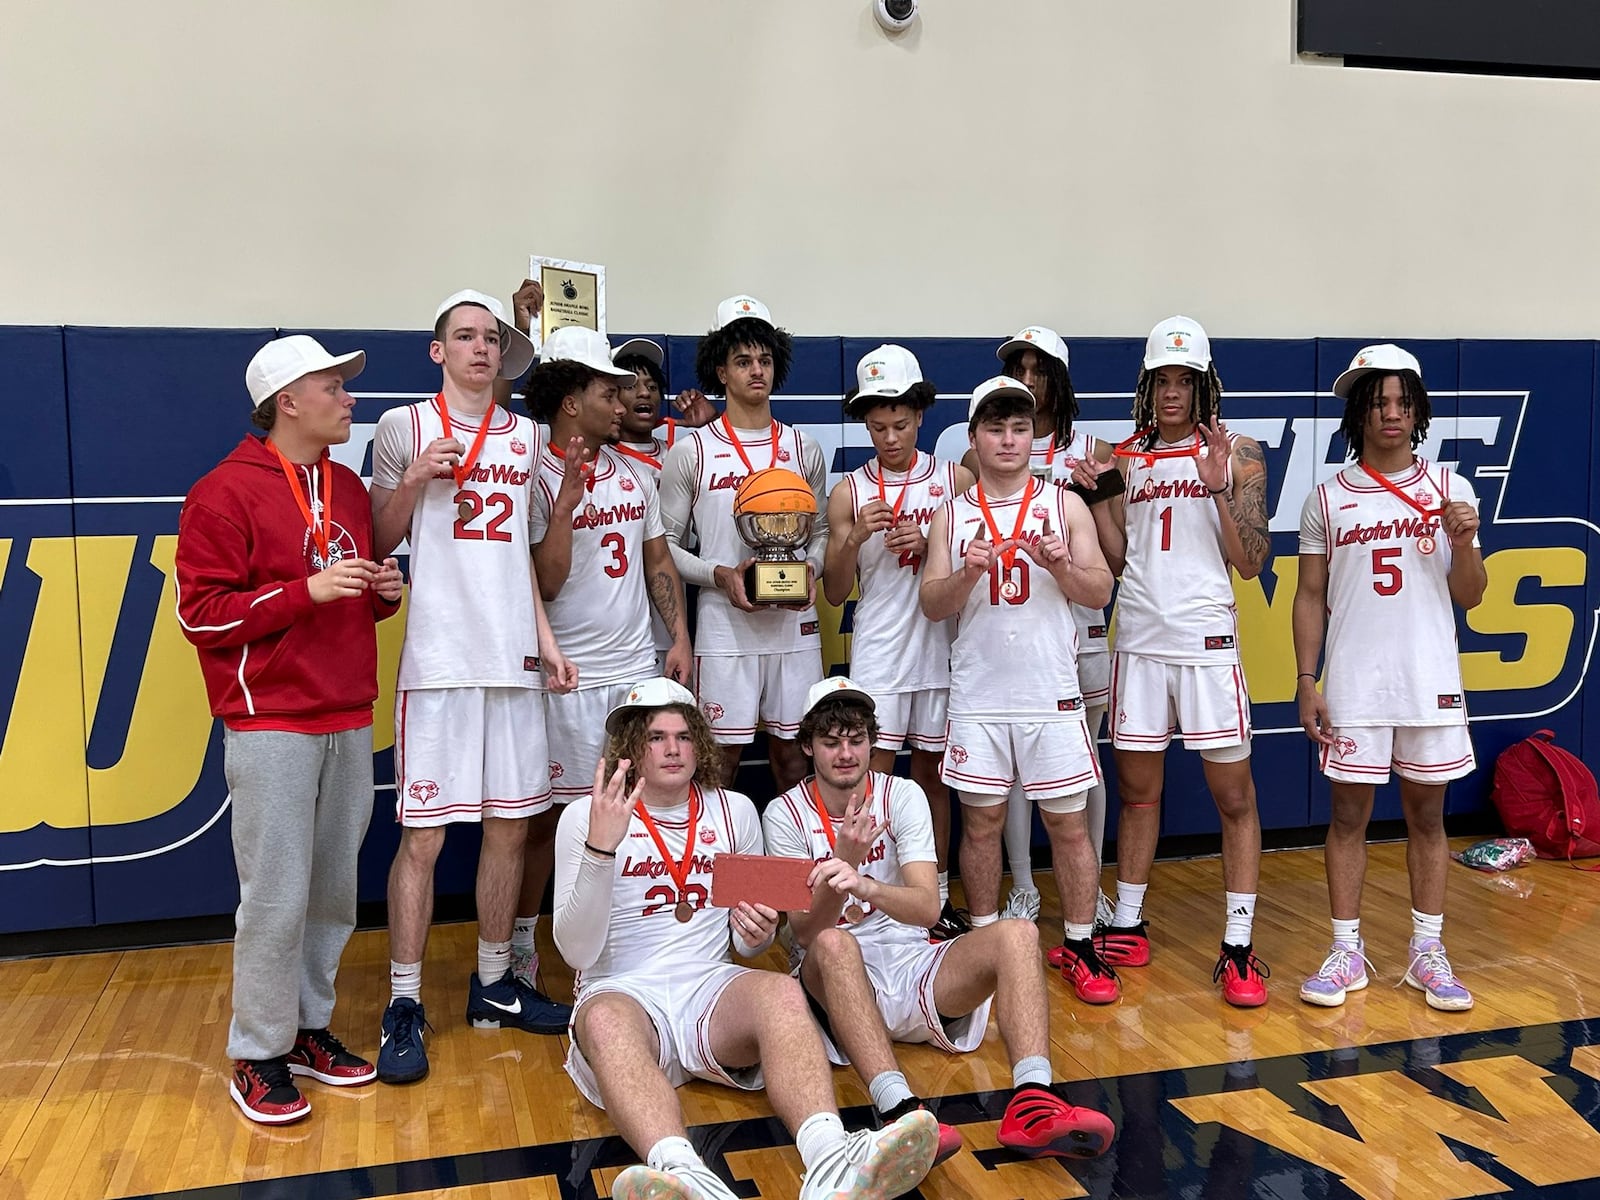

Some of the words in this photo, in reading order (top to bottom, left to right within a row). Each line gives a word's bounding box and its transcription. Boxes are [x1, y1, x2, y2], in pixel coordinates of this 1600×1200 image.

[1173, 479, 1211, 498] Wes
[453, 489, 513, 542] 22
[1159, 506, 1172, 551] 1
[1336, 521, 1394, 548] Lakota
[600, 531, 629, 579] 3
[898, 548, 921, 576] 4
[1371, 547, 1403, 597] 5
[988, 558, 1031, 605] 10
